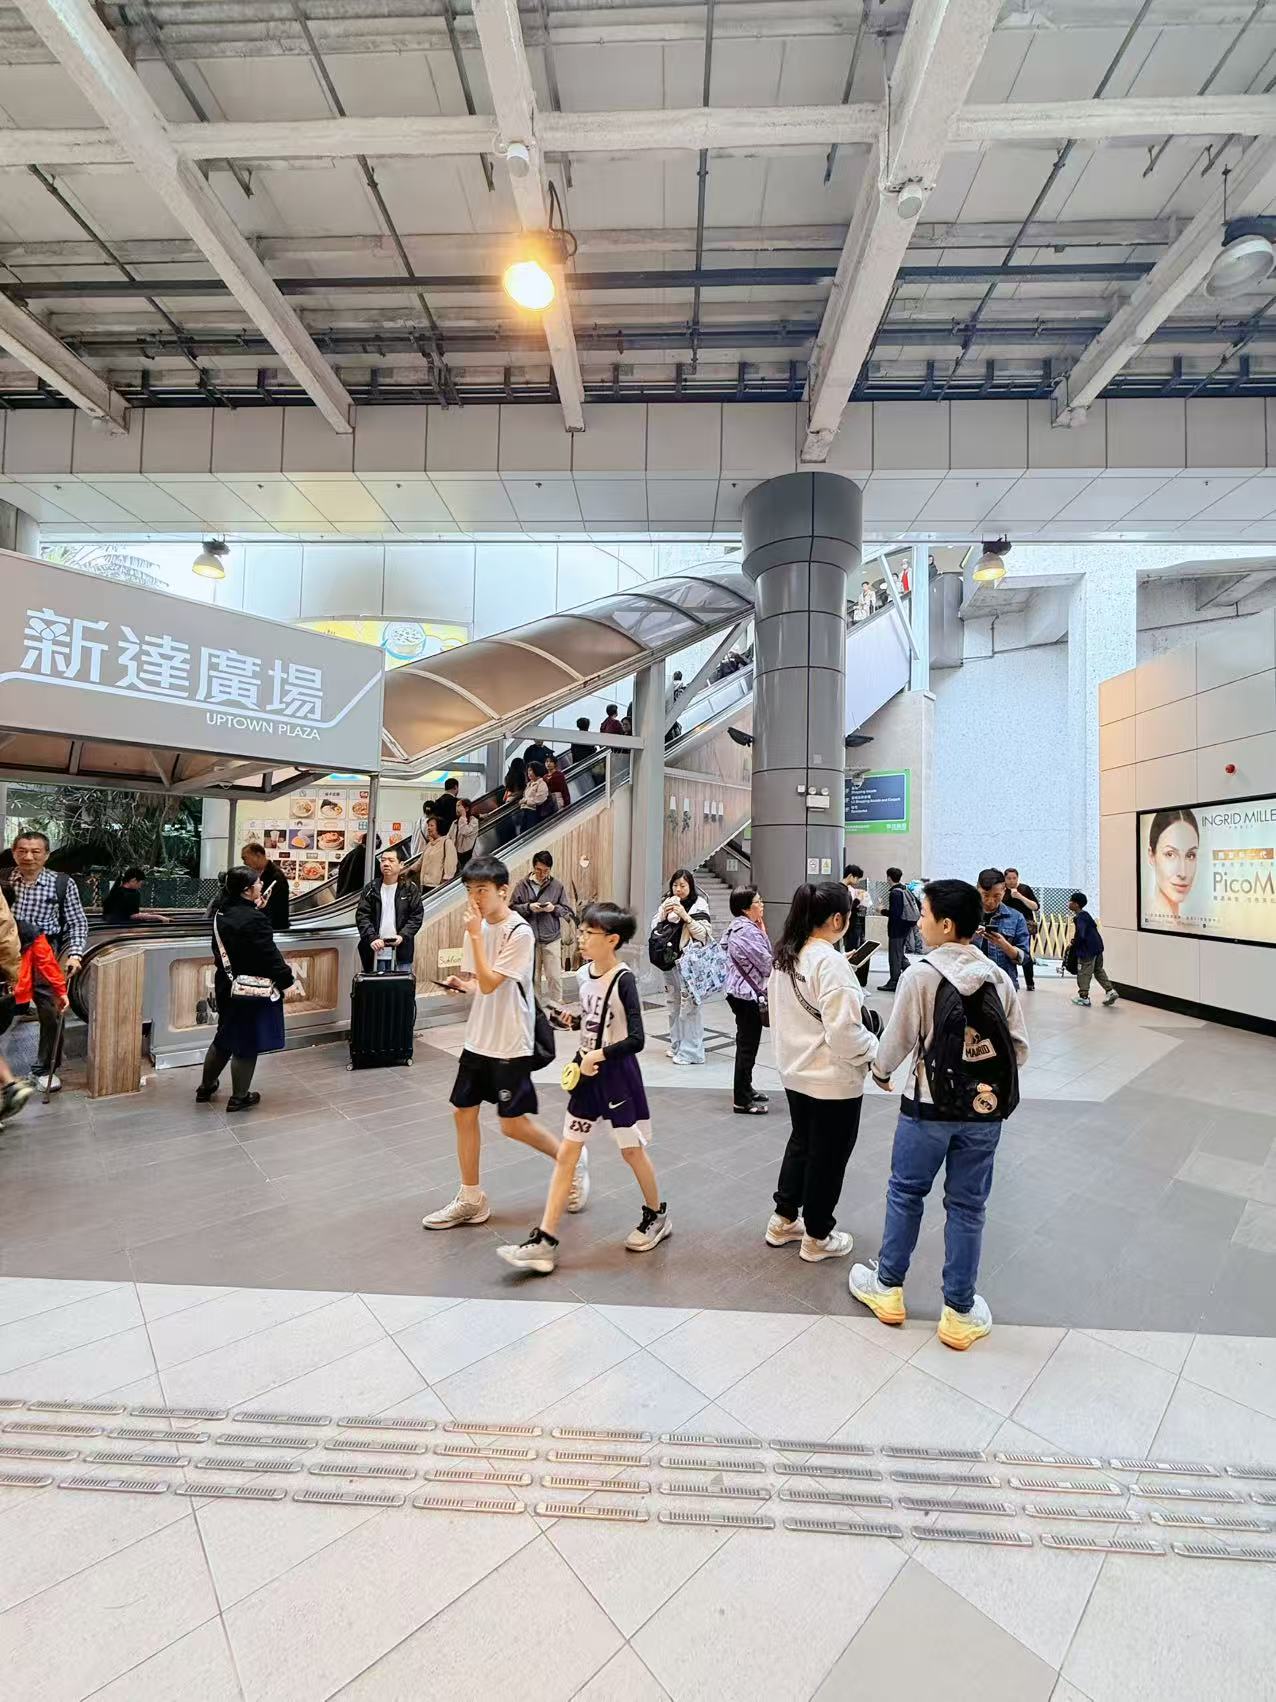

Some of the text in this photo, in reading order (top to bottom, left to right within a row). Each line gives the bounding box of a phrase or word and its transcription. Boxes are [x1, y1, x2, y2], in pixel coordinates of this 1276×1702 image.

[20, 608, 324, 720] 新達廣場
[206, 712, 321, 741] UPTOWN PLAZA
[1202, 812, 1242, 828] INGRID
